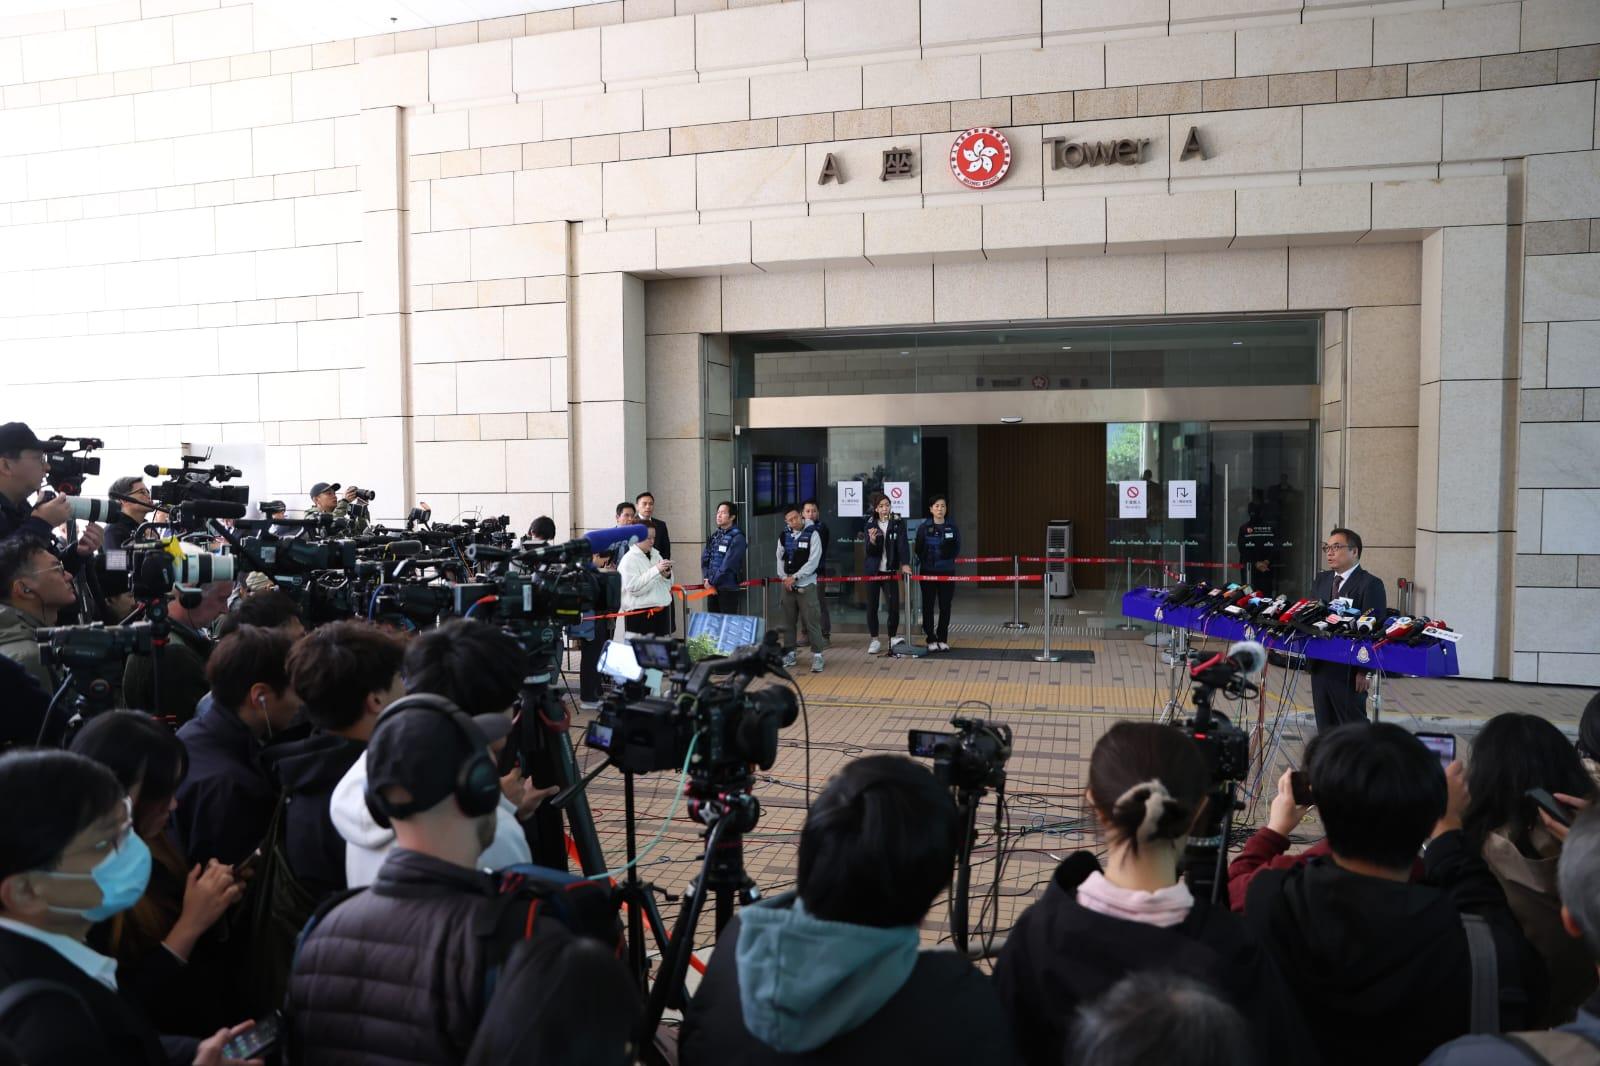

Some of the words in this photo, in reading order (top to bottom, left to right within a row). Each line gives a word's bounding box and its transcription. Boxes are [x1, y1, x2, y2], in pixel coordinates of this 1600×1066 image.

[818, 152, 844, 186] A
[879, 146, 914, 182] 座
[1042, 135, 1151, 171] Tower
[1180, 126, 1208, 162] A
